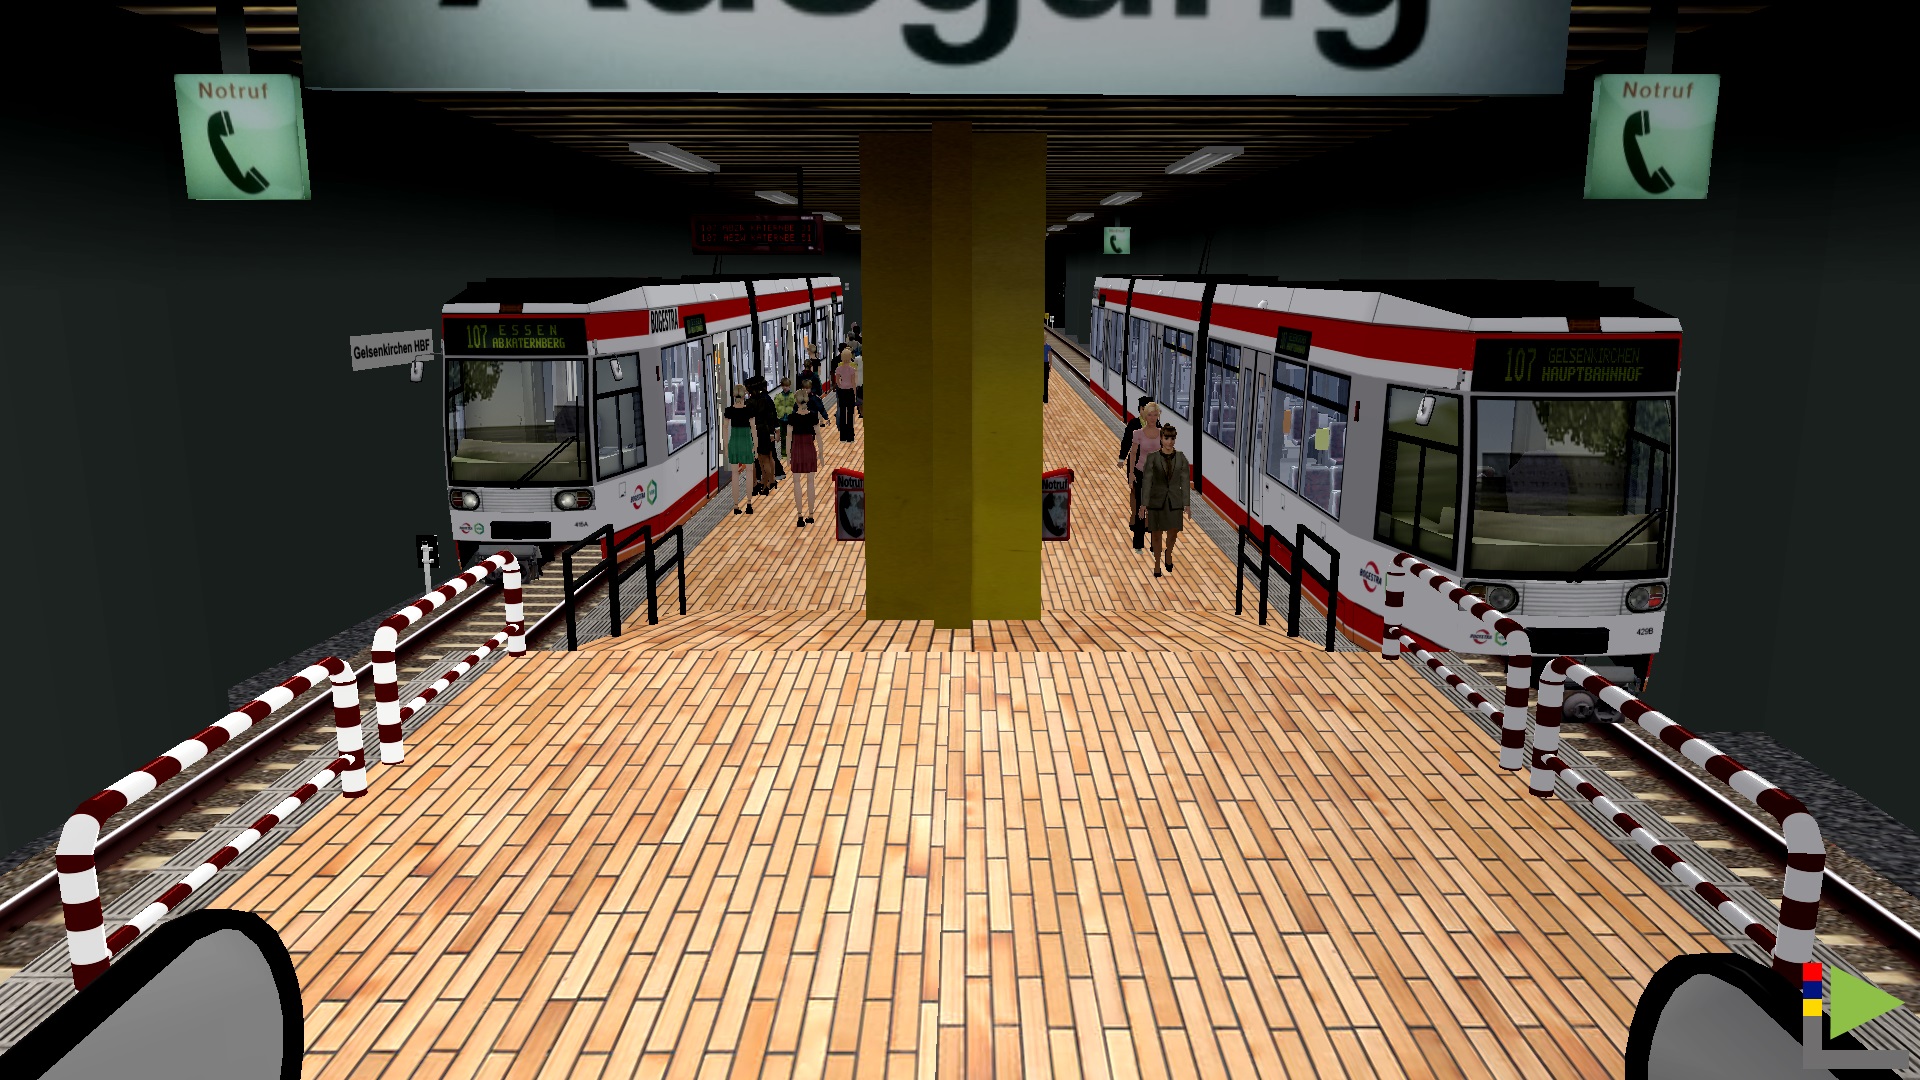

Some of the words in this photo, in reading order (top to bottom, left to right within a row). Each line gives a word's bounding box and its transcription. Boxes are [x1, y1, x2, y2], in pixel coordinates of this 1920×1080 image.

[198, 81, 268, 100] Notruf
[1622, 80, 1694, 99] Notruf
[650, 308, 679, 334] BOGESTRA
[466, 324, 488, 349] 107
[353, 341, 413, 360] Gelsenkirchen
[413, 338, 430, 353] HBF
[1504, 347, 1537, 382] 107
[1548, 347, 1641, 364] GELSENKIRCHEN
[1541, 366, 1644, 382] HAUPTBAHNHOF
[837, 475, 864, 488] Notruf
[1042, 478, 1068, 490] Notruf
